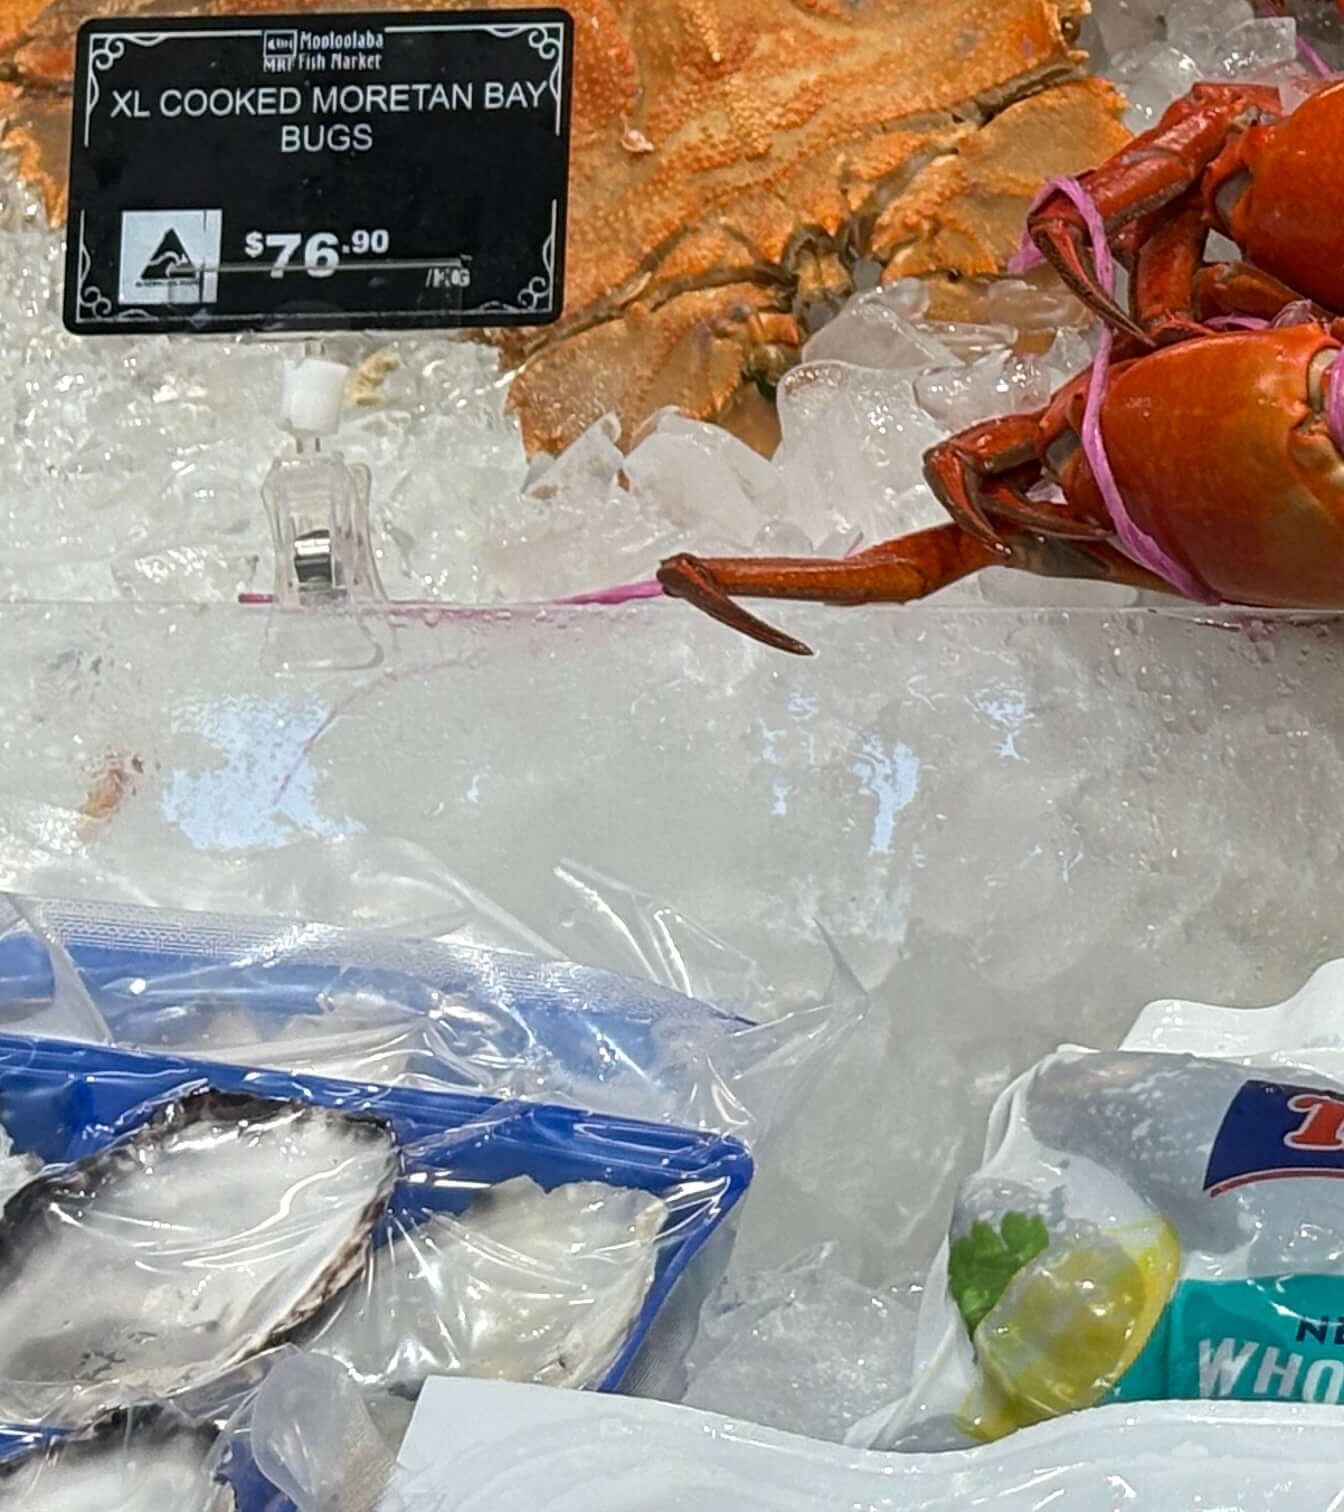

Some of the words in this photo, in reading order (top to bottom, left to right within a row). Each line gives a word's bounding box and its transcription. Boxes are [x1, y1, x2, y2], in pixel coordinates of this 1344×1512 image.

[300, 29, 384, 50] Mooloolaba
[299, 52, 326, 70] Fish
[331, 52, 382, 70] Market
[110, 91, 150, 118] XL
[160, 88, 302, 117] COOKED
[312, 83, 474, 115] MORETAN
[484, 81, 549, 110] BAY
[281, 124, 373, 153] BUGS
[245, 230, 390, 278] $76.90
